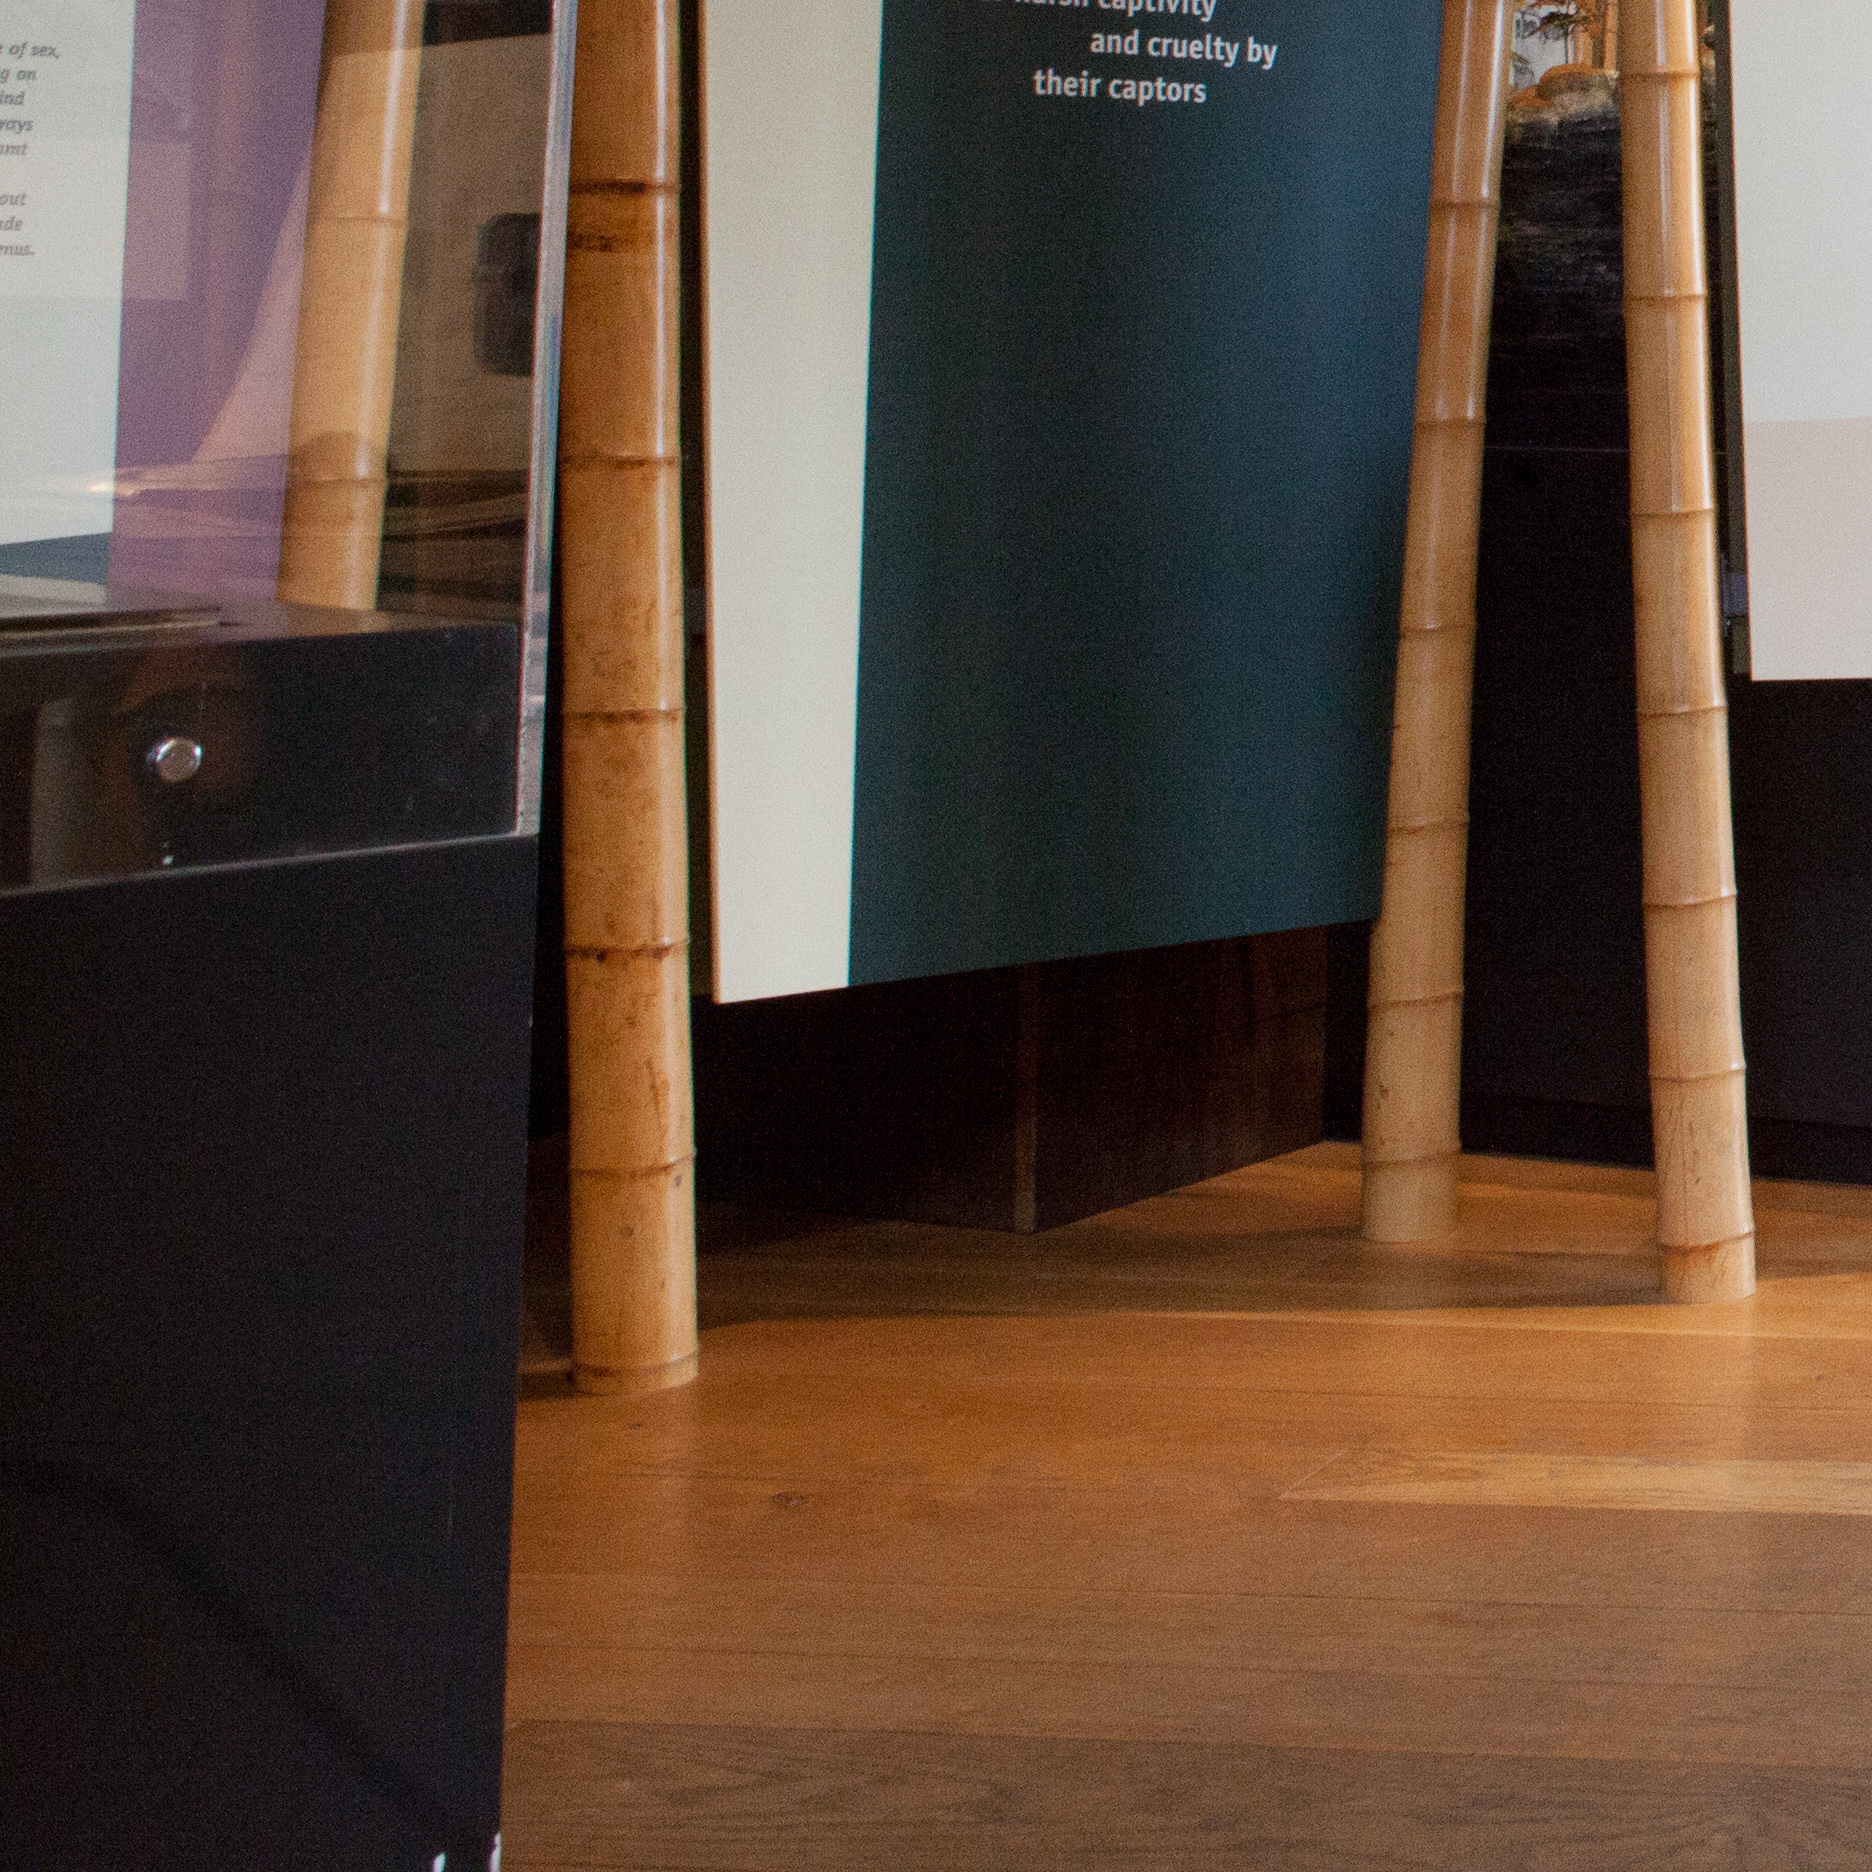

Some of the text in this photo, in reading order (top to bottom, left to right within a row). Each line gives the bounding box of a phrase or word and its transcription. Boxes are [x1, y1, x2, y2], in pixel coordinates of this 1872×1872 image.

[7, 41, 60, 60] of sex,
[1090, 28, 1278, 71] and cruelty by
[1034, 68, 1207, 107] their captors
